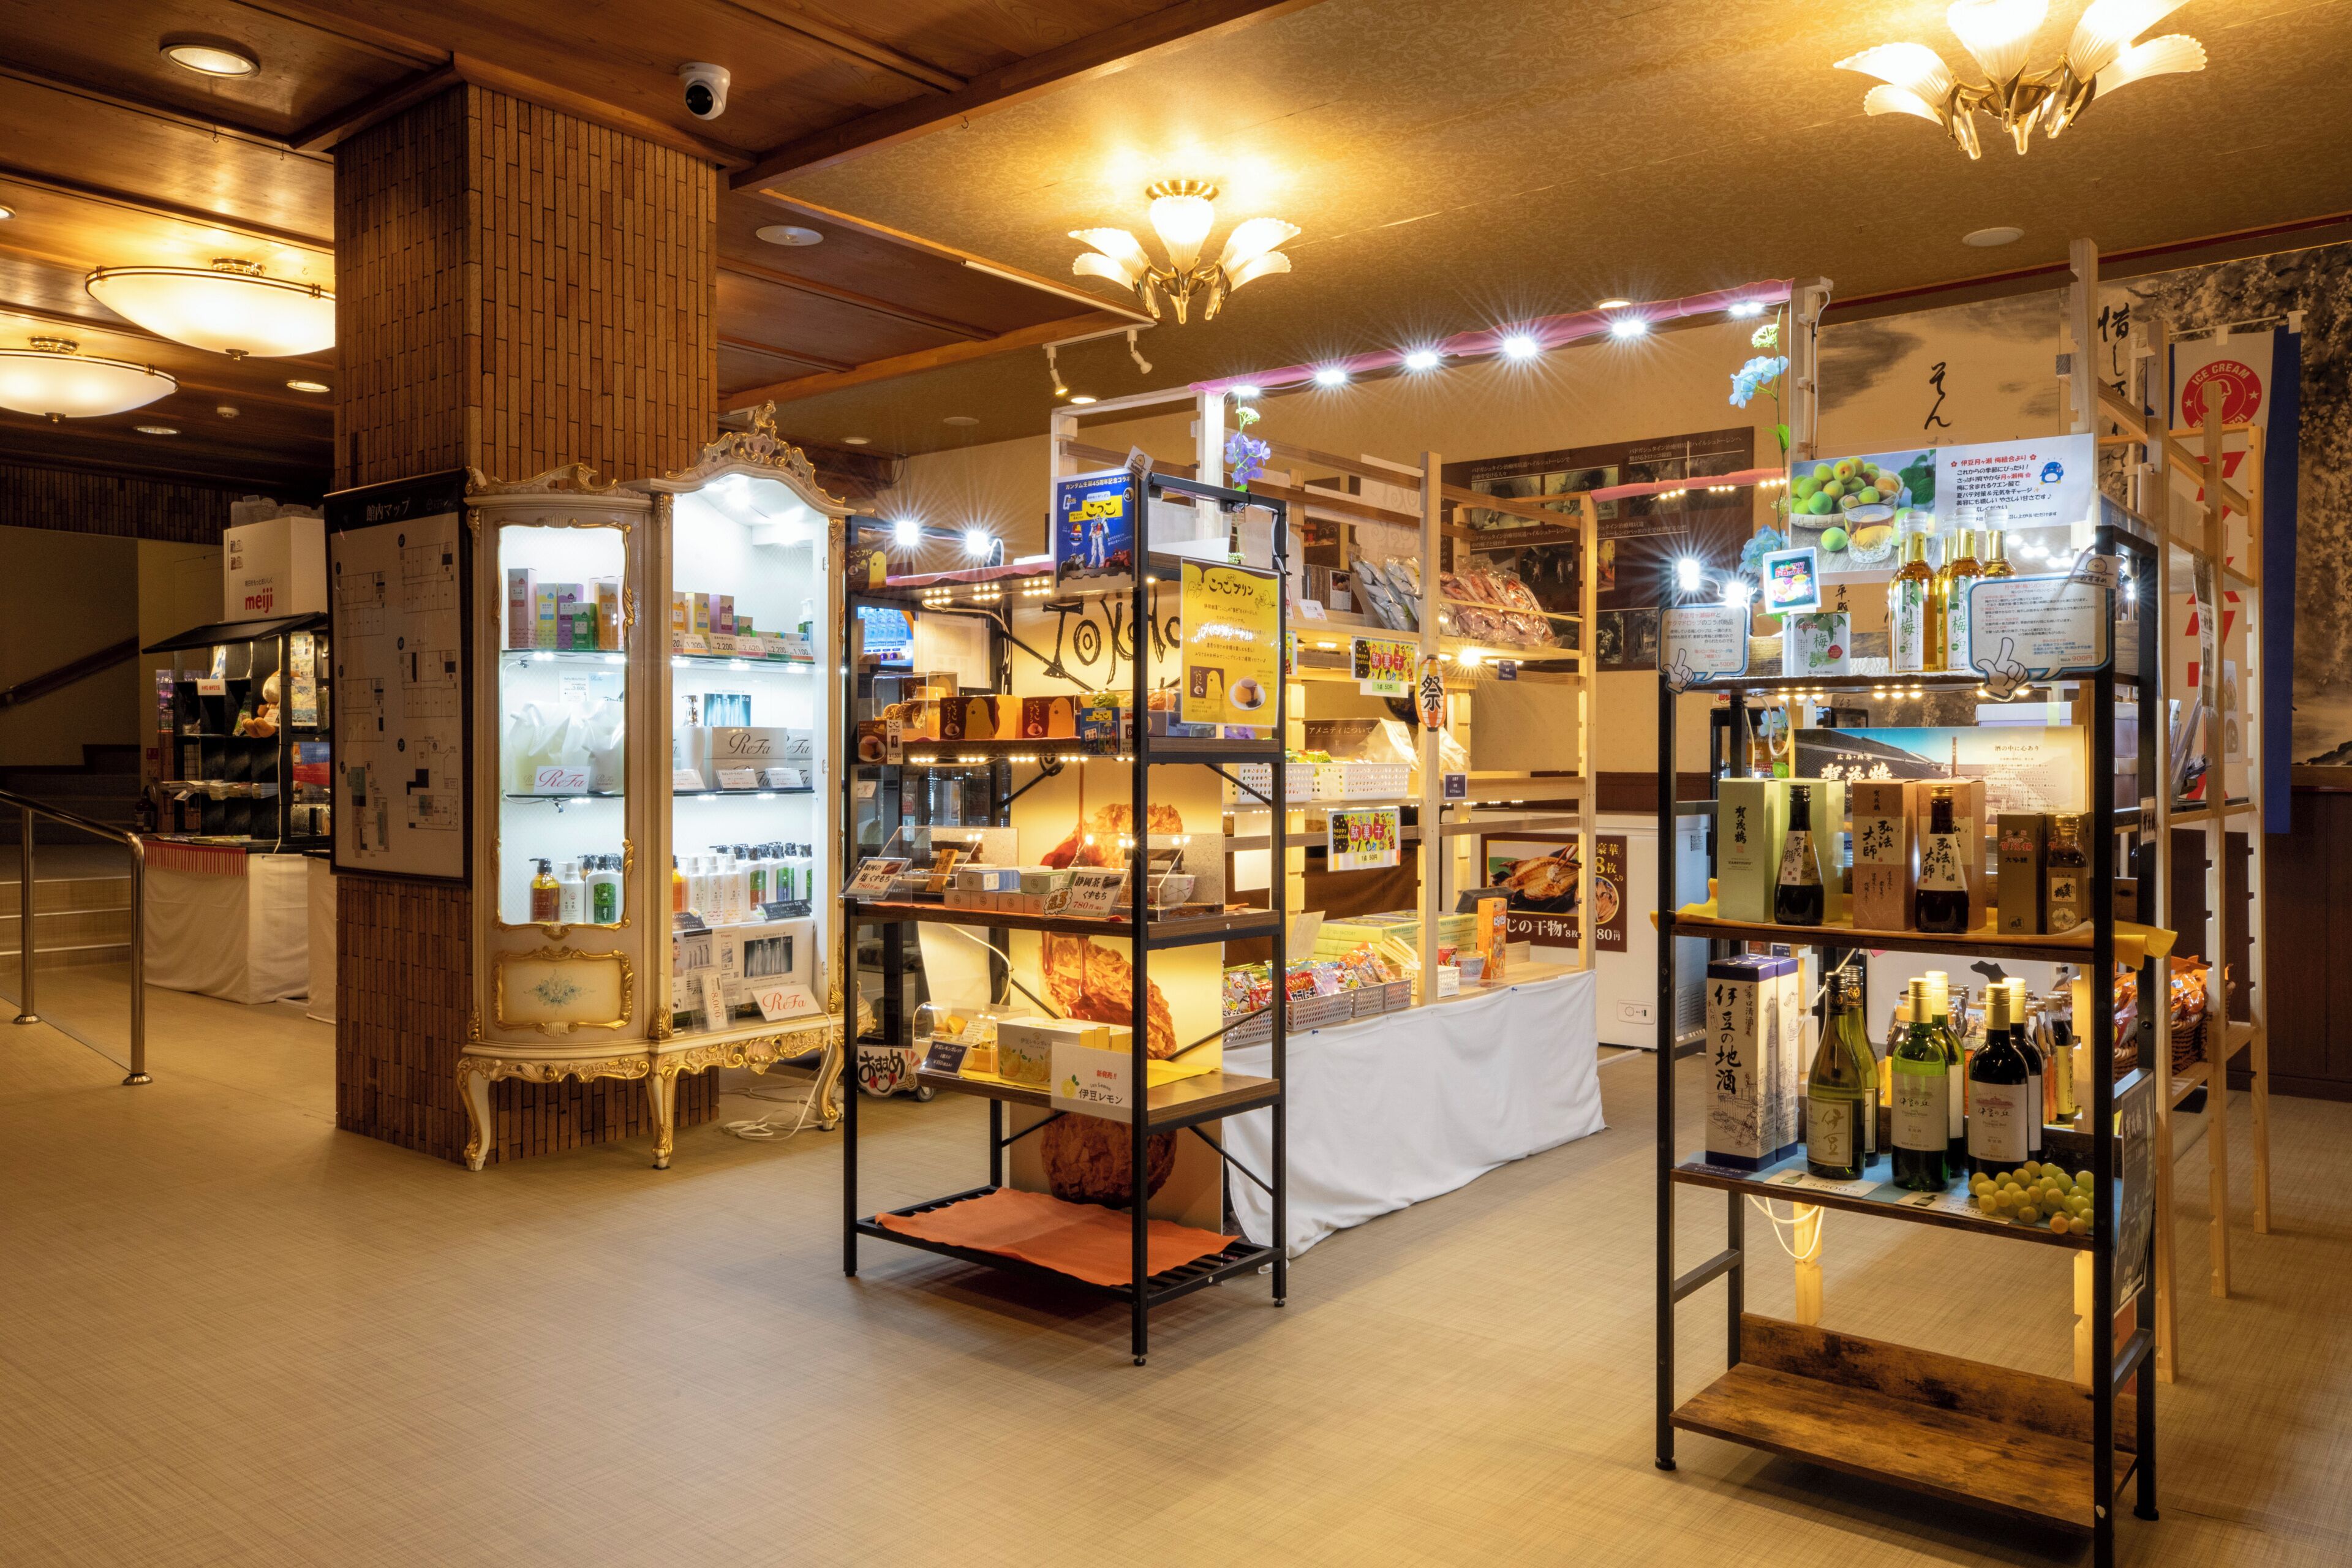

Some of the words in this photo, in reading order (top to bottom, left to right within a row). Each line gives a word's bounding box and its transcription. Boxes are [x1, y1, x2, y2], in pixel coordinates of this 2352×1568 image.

[2192, 367, 2209, 386] ICE
[2212, 363, 2251, 380] CREAM
[366, 497, 411, 522] 館内マップ
[1209, 578, 1254, 597] こっこプリン
[245, 587, 273, 613] meiji
[1900, 617, 1916, 660] 梅シロップ
[1952, 615, 1967, 657] 梅シロップ
[1371, 652, 1404, 669] 駄菓子
[1420, 674, 1444, 712] 祭
[1309, 726, 1373, 735] アメニティについて
[727, 733, 774, 755] ReFa
[536, 769, 586, 788] ReFa
[1351, 825, 1383, 840] 駄菓子
[1735, 805, 1747, 845] 賀茂鶴
[1596, 842, 1619, 856] 豪華
[1596, 856, 1617, 874] 8枚
[1074, 876, 1101, 888] 静岡茶
[1083, 891, 1107, 900] くずもち
[761, 990, 808, 1013] ReFa
[1714, 984, 1741, 1095] 伊豆の地酒
[858, 1048, 905, 1084] おすすめ
[1078, 1088, 1123, 1105] 伊豆レモン
[1821, 1108, 1845, 1156] 伊豆
